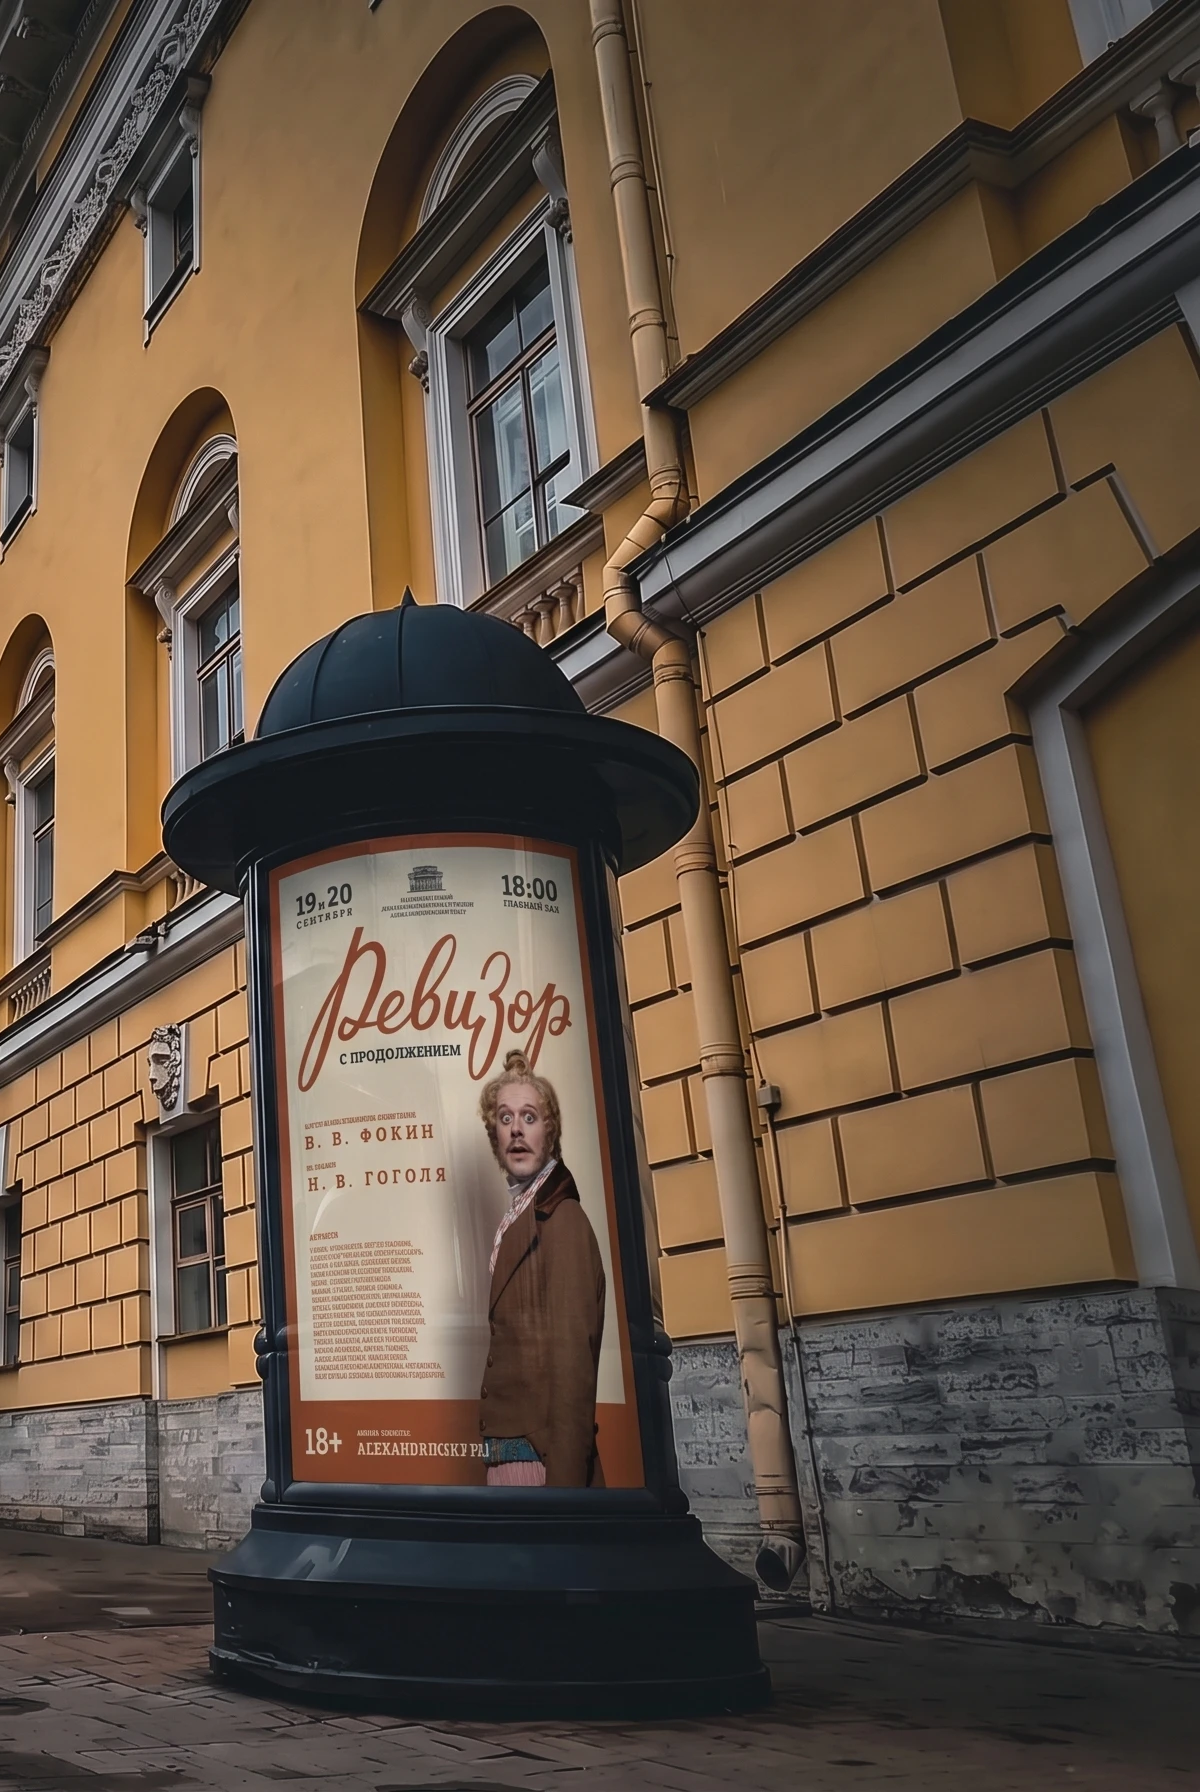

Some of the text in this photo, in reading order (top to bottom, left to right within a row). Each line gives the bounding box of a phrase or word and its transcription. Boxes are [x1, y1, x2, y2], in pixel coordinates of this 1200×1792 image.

[295, 891, 317, 917] 19
[327, 883, 353, 908] 20
[501, 874, 558, 902] 18:00
[298, 926, 573, 1092] Ревизор
[350, 1044, 462, 1064] ПРОДОЛЖЕНИЕМ
[360, 1123, 434, 1143] ФОКИН
[364, 1167, 447, 1186] ГОГОЛЯ
[305, 1427, 343, 1455] 18+
